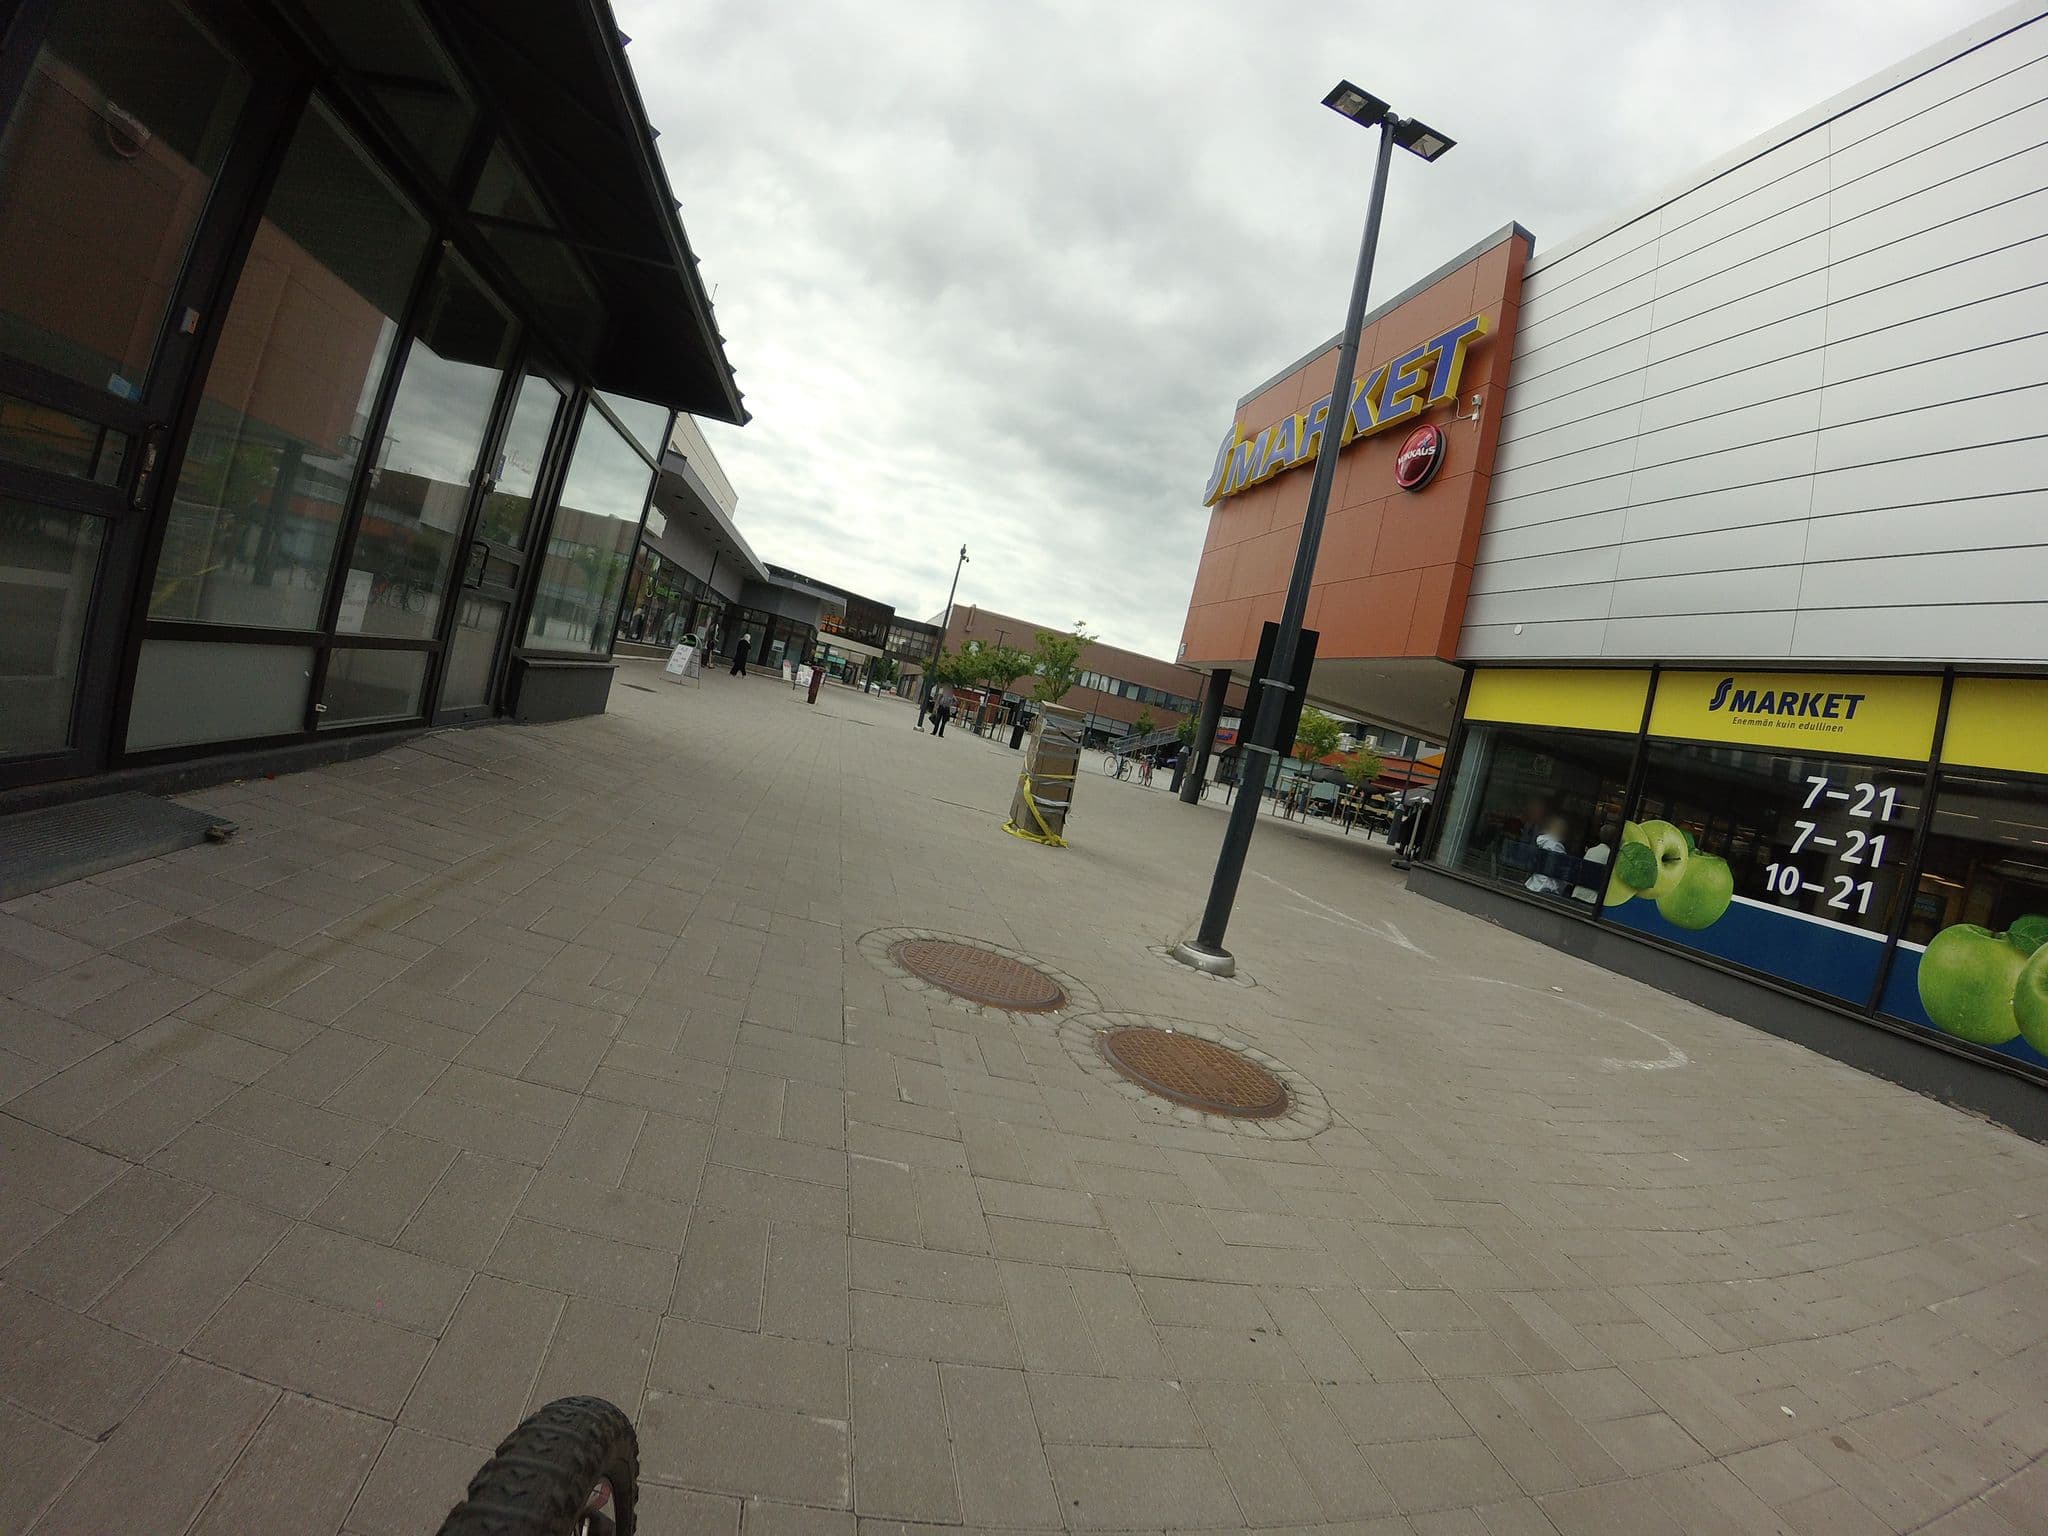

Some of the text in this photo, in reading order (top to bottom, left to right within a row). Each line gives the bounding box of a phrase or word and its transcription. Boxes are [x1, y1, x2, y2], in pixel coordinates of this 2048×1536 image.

[1732, 716, 1844, 733] Enemmän kuin edullinen
